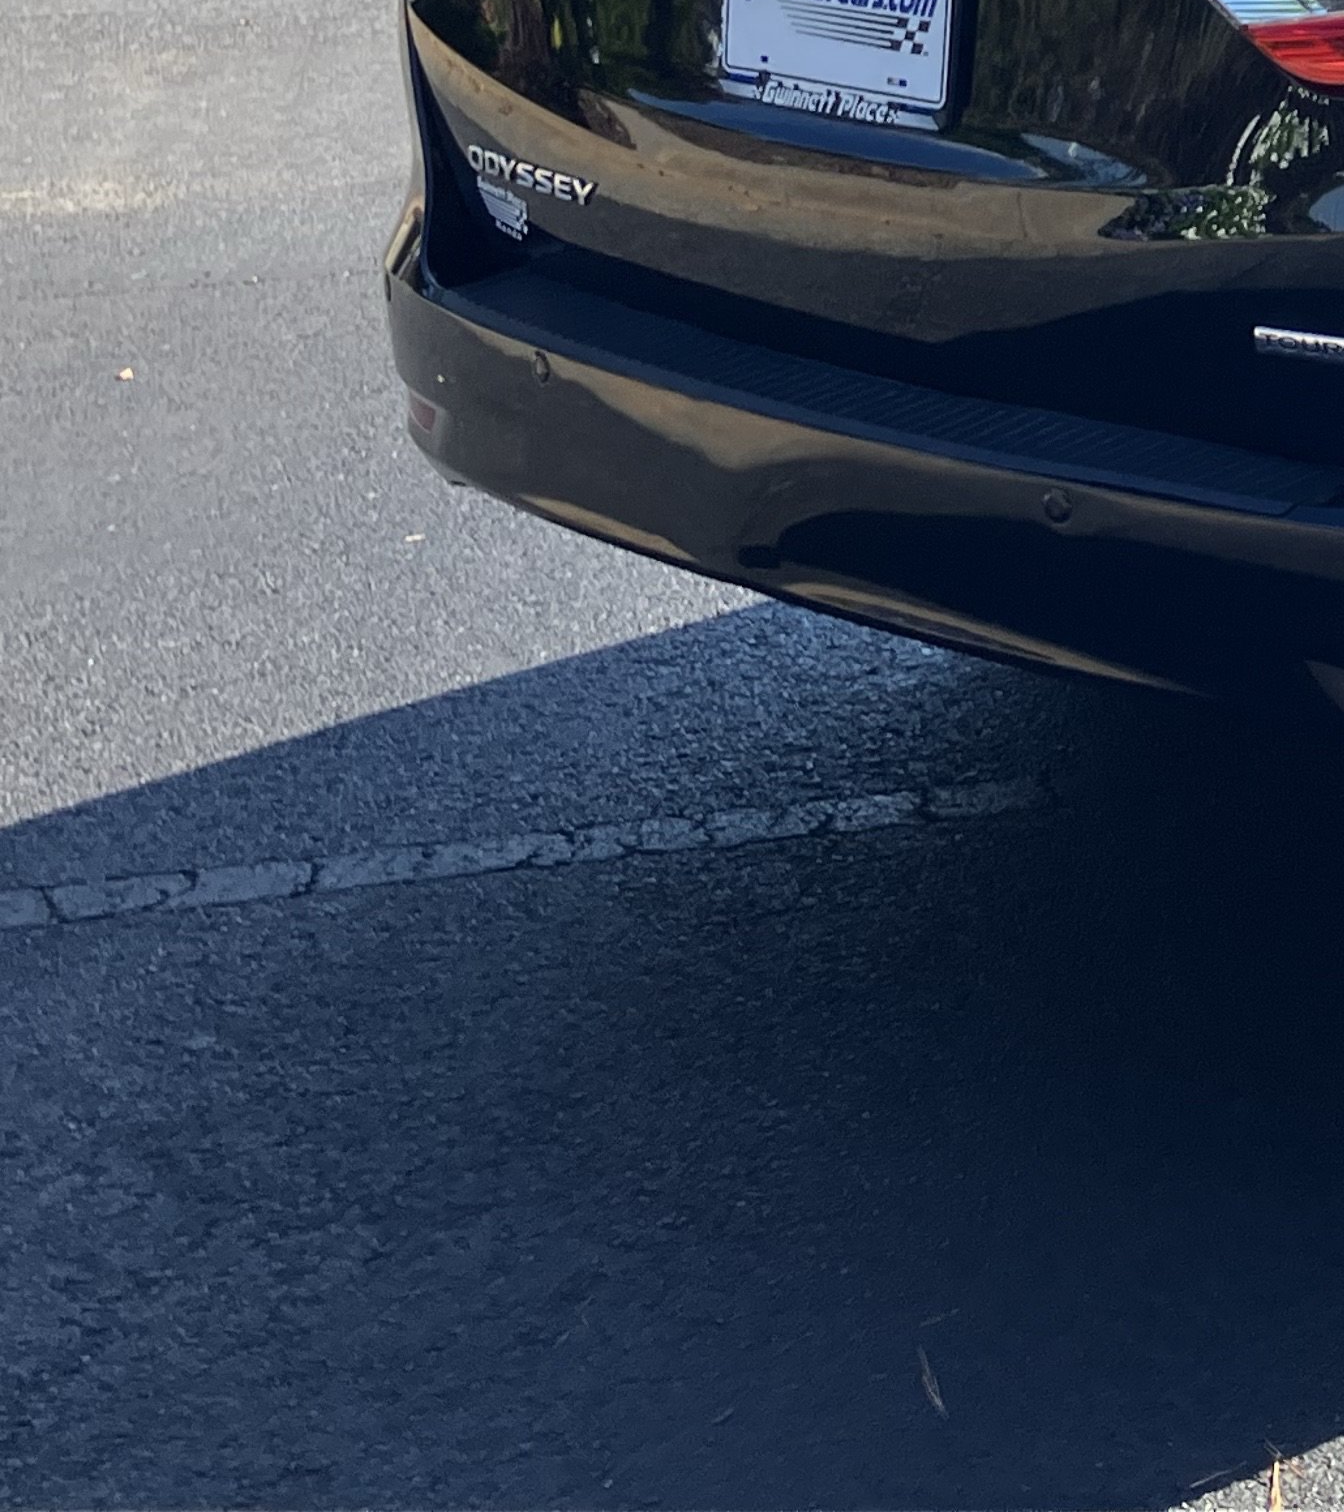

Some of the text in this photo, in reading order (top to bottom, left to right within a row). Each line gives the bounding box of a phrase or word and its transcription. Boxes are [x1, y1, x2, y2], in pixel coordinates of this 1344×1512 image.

[761, 78, 888, 122] Gwinnett Place
[467, 144, 595, 206] ODYSSEY
